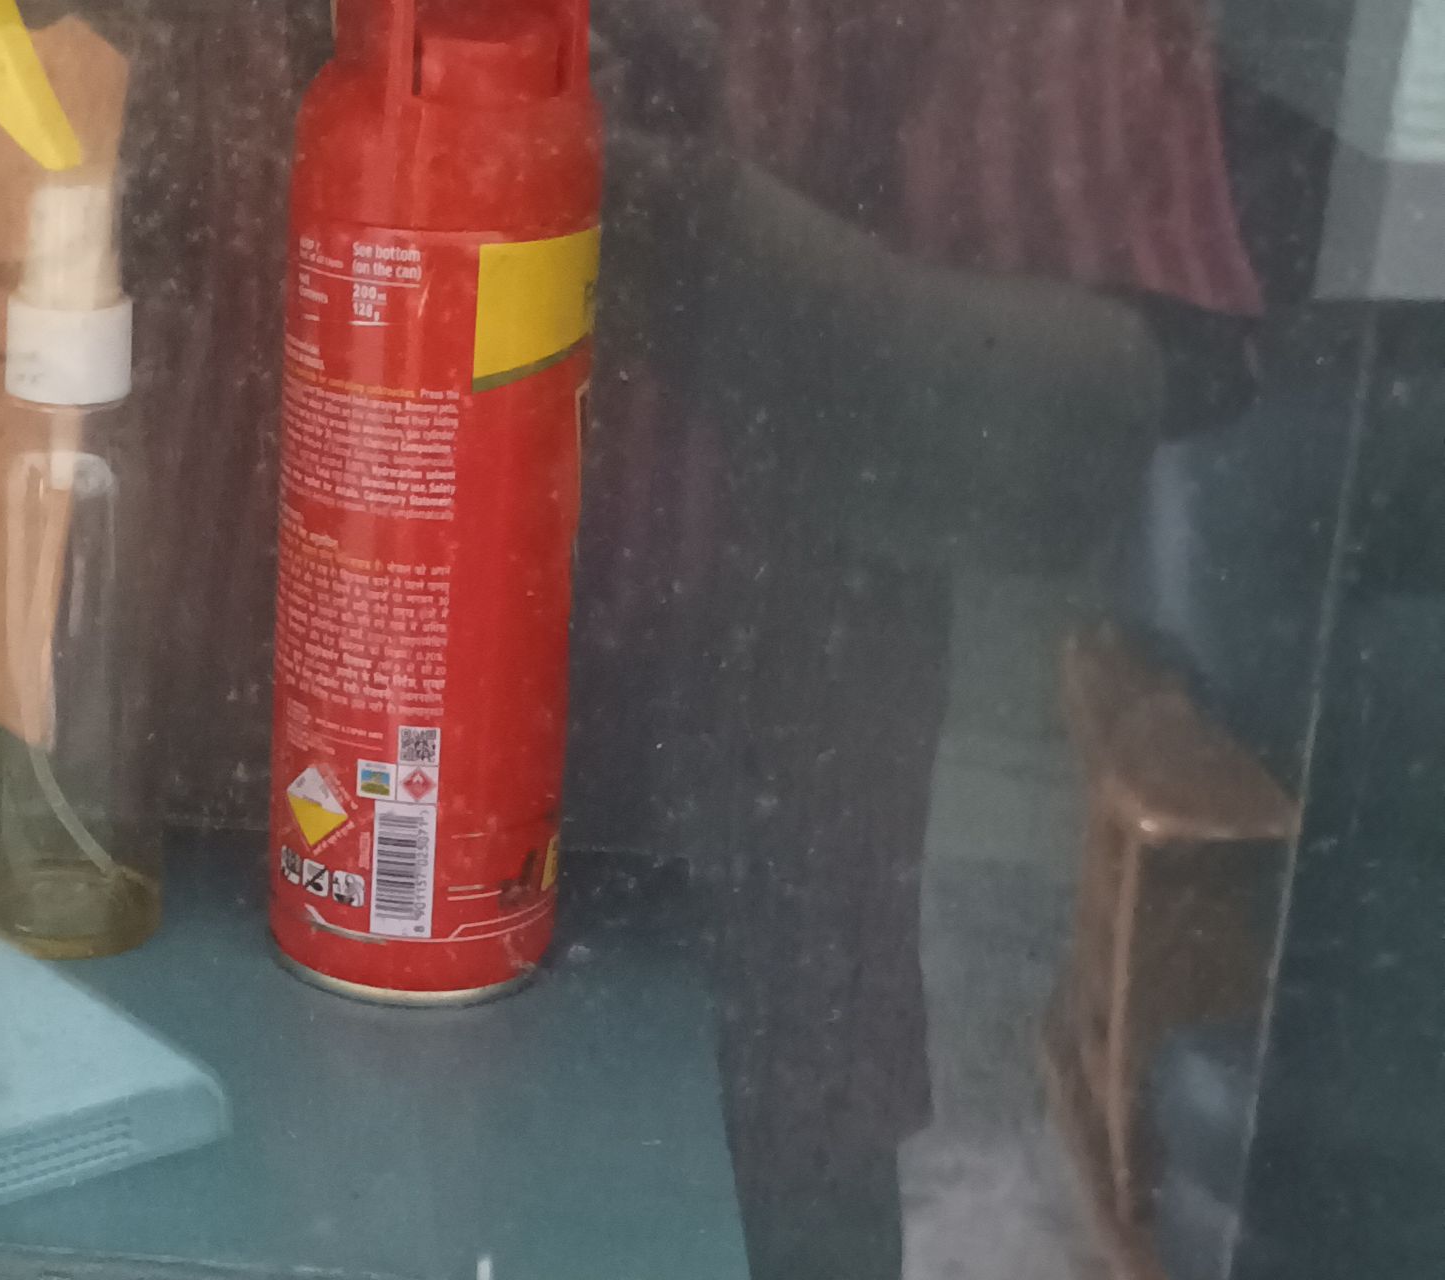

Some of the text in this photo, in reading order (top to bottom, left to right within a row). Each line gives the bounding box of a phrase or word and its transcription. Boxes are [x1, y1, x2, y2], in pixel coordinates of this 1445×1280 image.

[352, 241, 421, 262] See bottom
[352, 260, 370, 275] (on
[373, 261, 392, 277] the
[395, 264, 422, 281] can)
[352, 283, 377, 300] 200
[413, 923, 426, 934] 8
